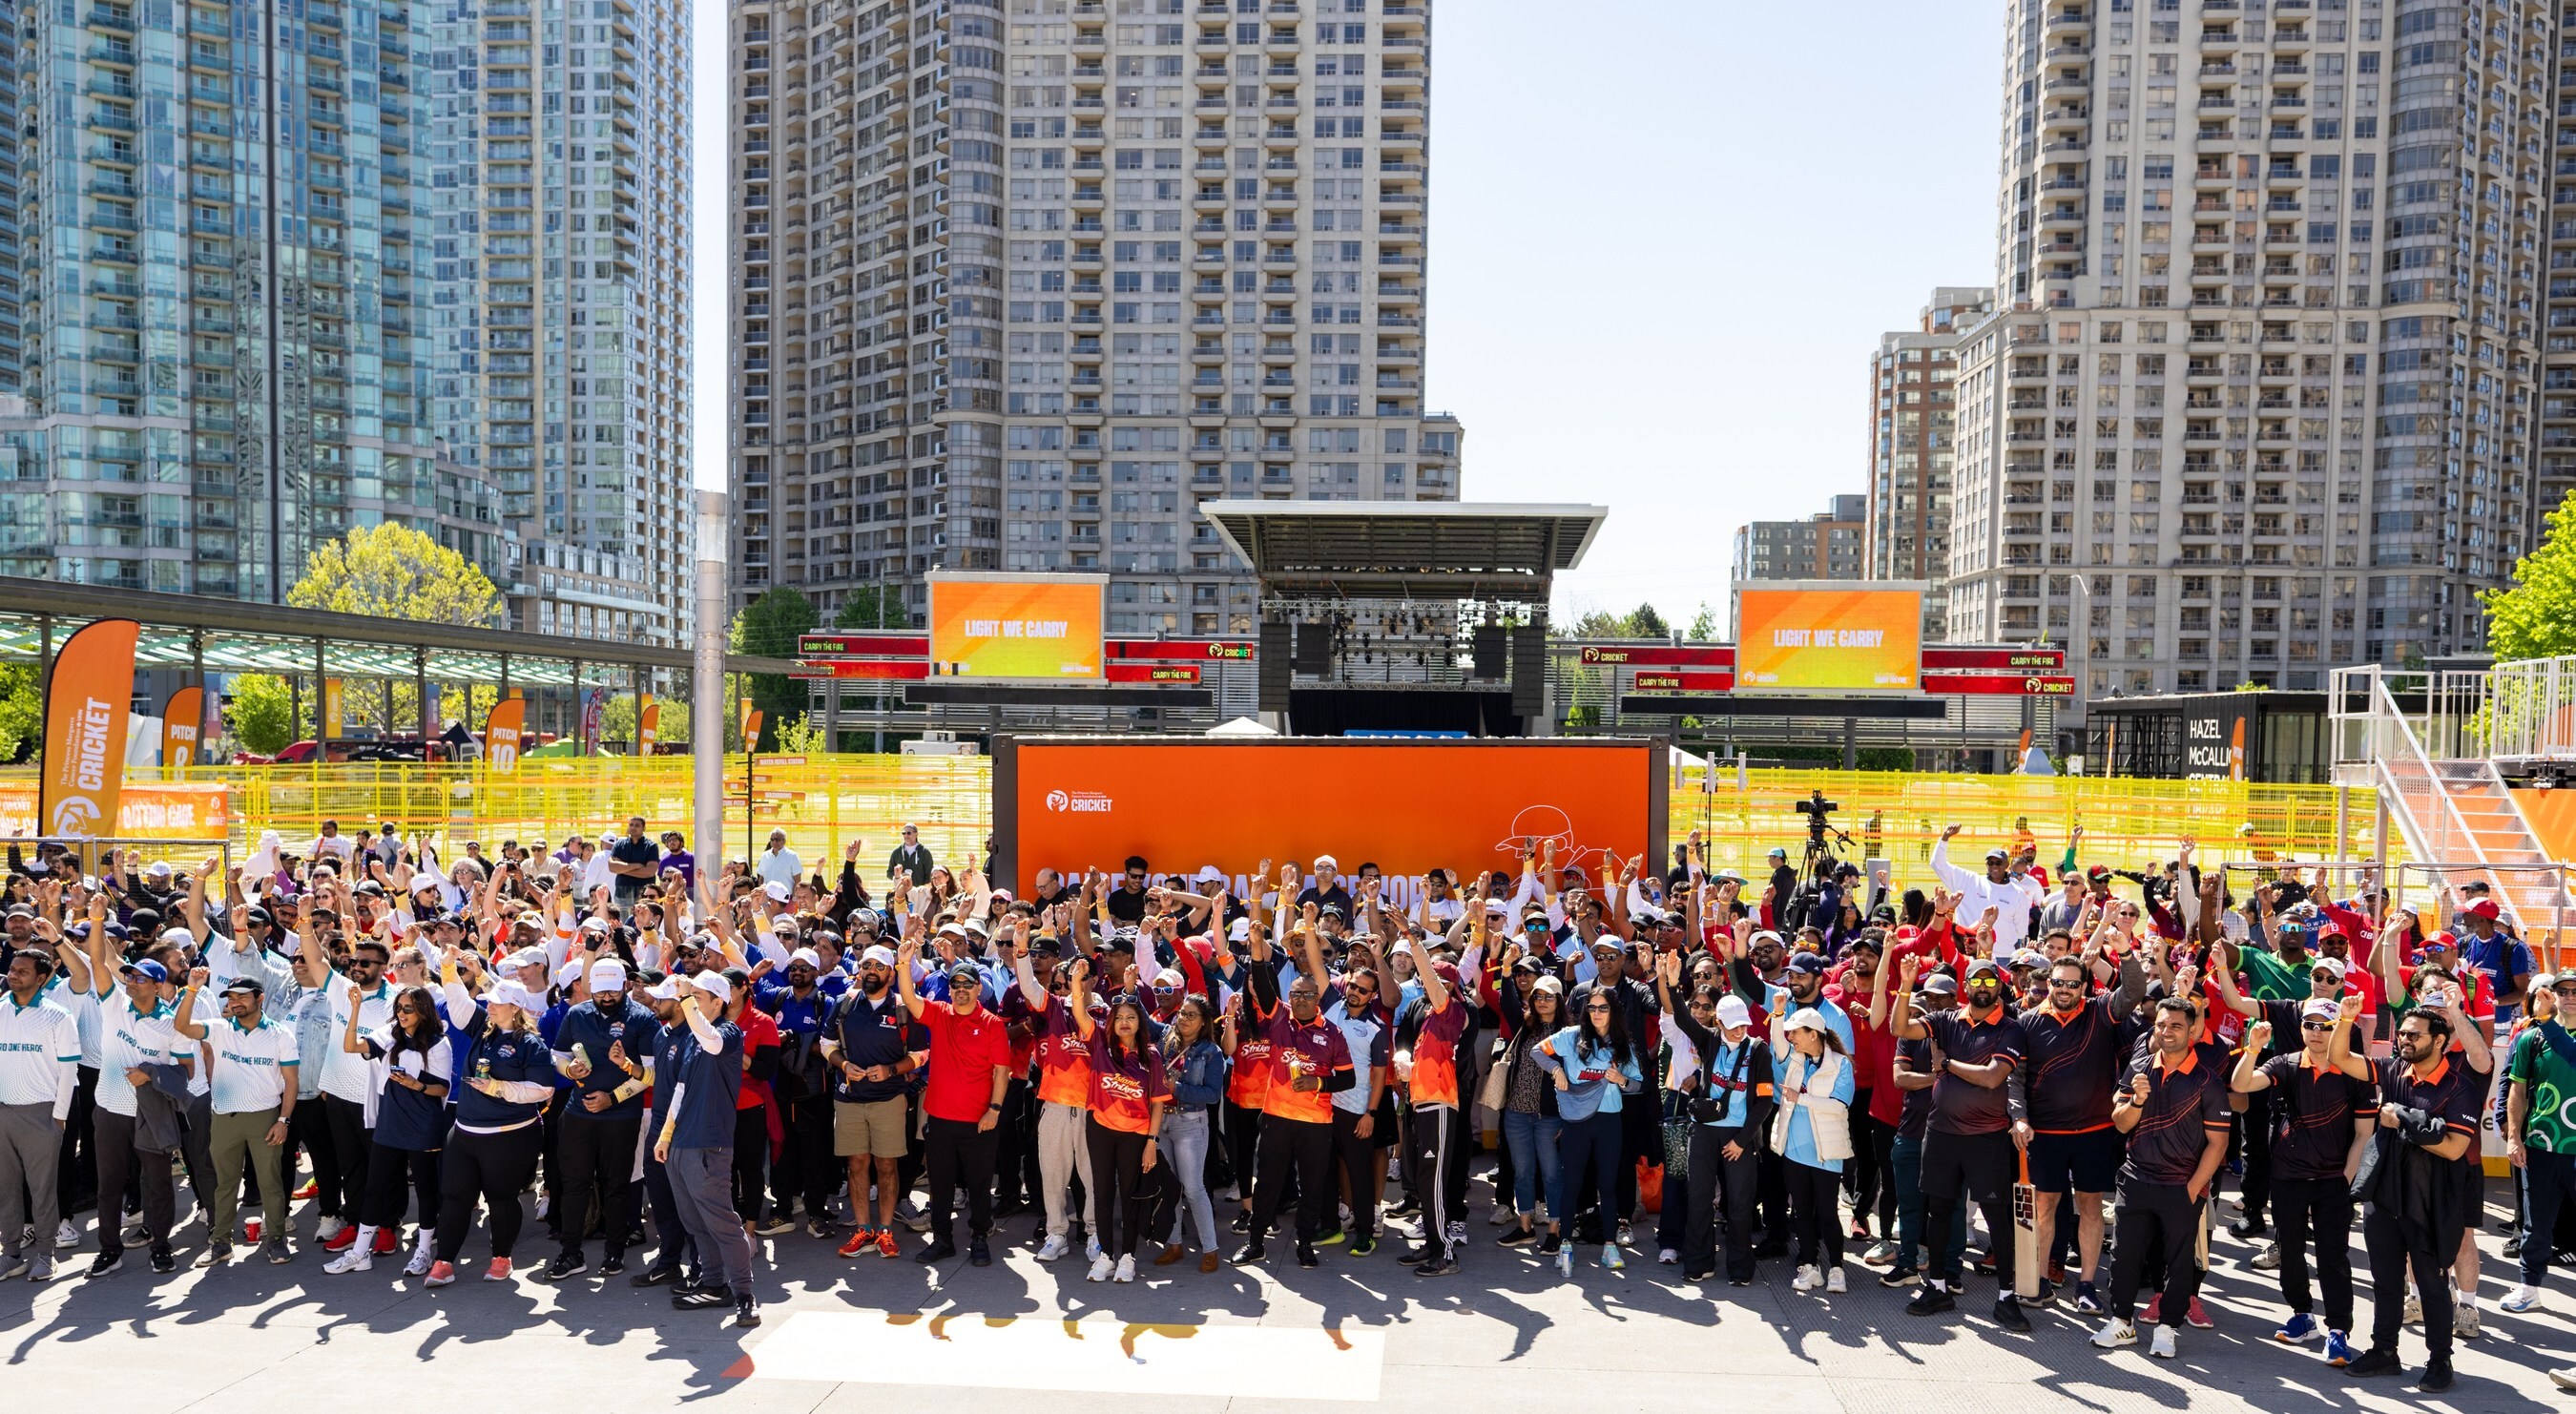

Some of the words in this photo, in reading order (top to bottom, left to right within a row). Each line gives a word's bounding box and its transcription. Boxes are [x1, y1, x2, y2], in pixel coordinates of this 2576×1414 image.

[965, 620, 1000, 636] LIGHT
[1003, 621, 1024, 637] WE
[1026, 620, 1068, 637] CARRY
[1774, 630, 1811, 647] LIGHT
[1814, 630, 1836, 647] WE
[1839, 630, 1884, 647] CARRY
[803, 642, 822, 651] CARRY
[822, 641, 832, 651] THE
[832, 643, 844, 652] FIRE
[1224, 648, 1252, 657] CRICKET
[1600, 653, 1629, 662] CRICKET
[2010, 656, 2030, 666] CARRY
[2031, 655, 2042, 666] THE
[2042, 656, 2055, 666] FIRE
[1153, 671, 1171, 679] CARRY
[1171, 670, 1180, 679] THE
[1180, 671, 1192, 679] FIRE
[1638, 677, 1657, 687] CARRY
[1657, 676, 1667, 686] THE
[1667, 678, 1679, 687] FIRE
[2043, 683, 2073, 693] CRICKET
[65, 717, 75, 747] Margaret
[171, 724, 197, 741] PITCH
[492, 727, 518, 740] PITCH
[2190, 718, 2221, 738] HAZEL
[71, 728, 81, 767] Foundation
[77, 697, 112, 791] CRICKET
[61, 747, 72, 774] Princess
[491, 743, 516, 775] 10
[68, 766, 77, 787] Cancer
[1070, 799, 1112, 812] CRICKET
[286, 1013, 298, 1023] ONE
[8, 1043, 21, 1052] ONE
[22, 1043, 43, 1053] HEROS
[253, 1057, 274, 1067] HEROS
[1111, 1072, 1141, 1088] Island
[1100, 1076, 1144, 1099] Strikers
